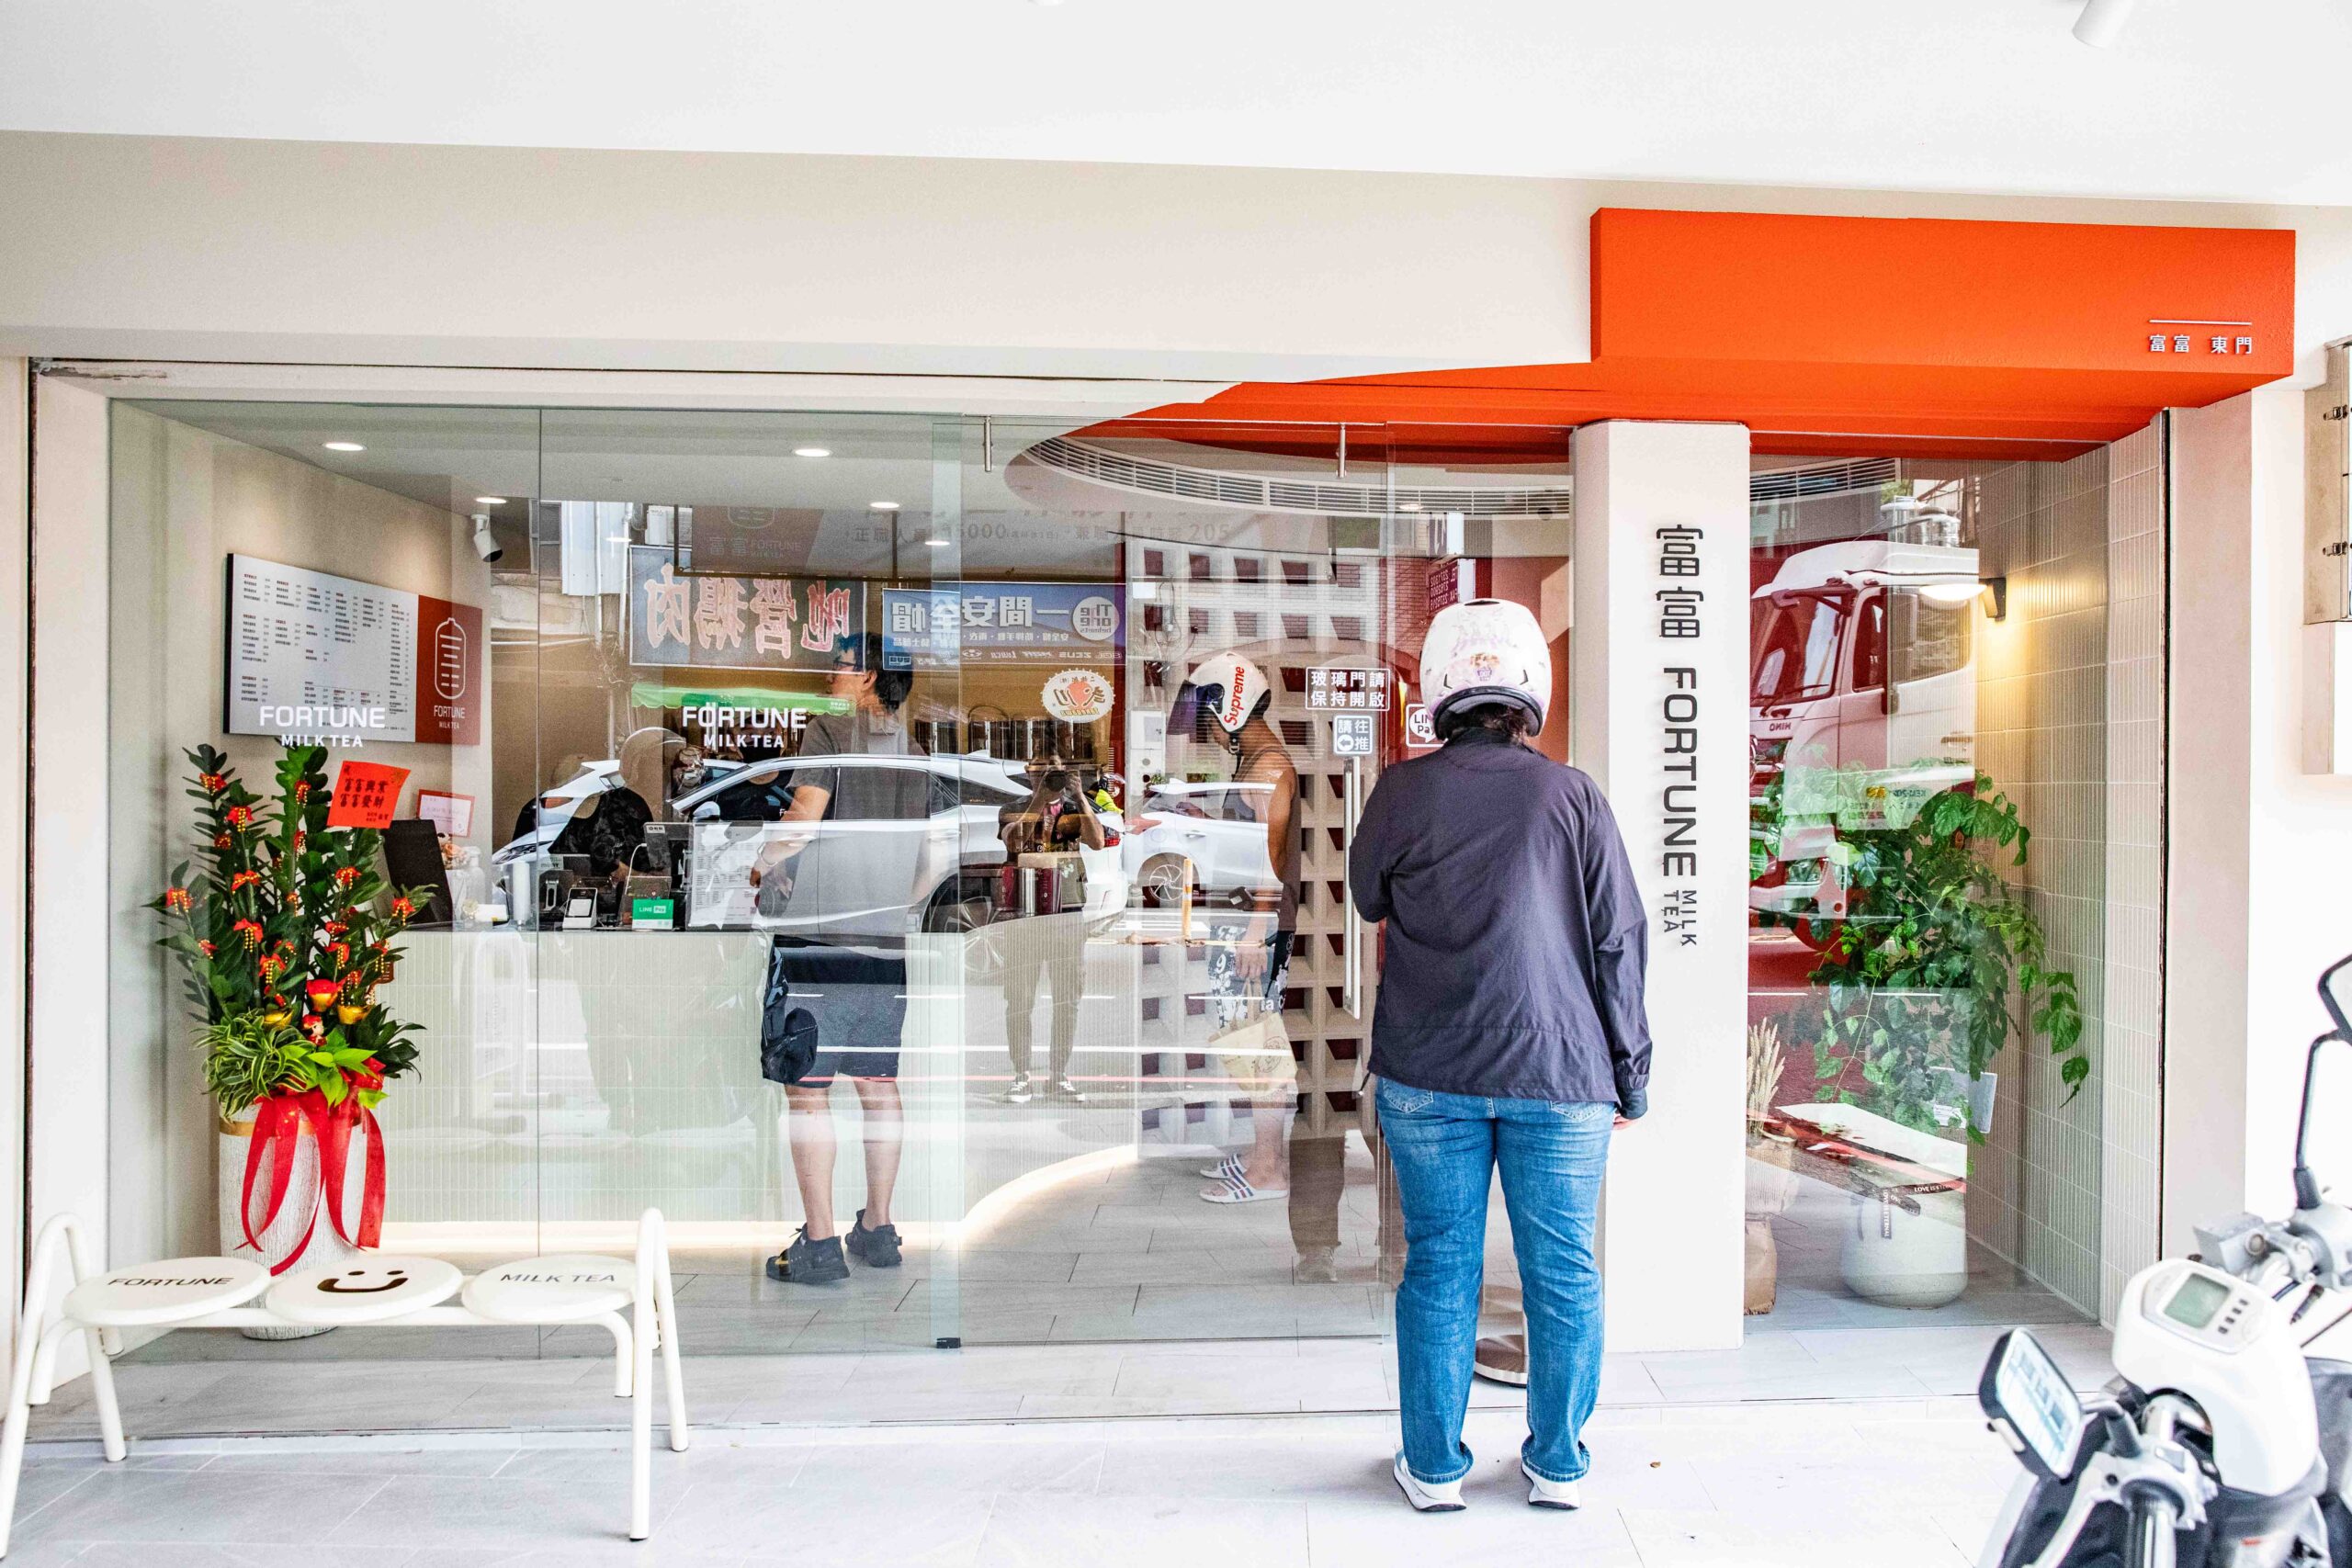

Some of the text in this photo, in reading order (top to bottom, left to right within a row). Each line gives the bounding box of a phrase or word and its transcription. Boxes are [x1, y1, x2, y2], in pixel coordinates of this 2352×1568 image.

[2149, 334, 2253, 354] 富富 東門
[1656, 524, 1704, 637] 富富
[1311, 671, 1385, 688] 玻璃門請
[1224, 666, 1245, 726] Supreme
[1311, 691, 1385, 708] 保持開啟
[260, 705, 385, 728] FORTUNE
[434, 705, 466, 719] FORTUNE
[683, 706, 807, 728] FORTUNE
[1338, 719, 1369, 734] 請往
[281, 735, 363, 748] MILK TEA
[704, 734, 785, 748] MILK TEA
[1354, 737, 1369, 750] 推
[1662, 668, 1698, 876] FORTUNE
[1664, 889, 1679, 933] TEA
[1681, 889, 1698, 946] MILK
[107, 1277, 233, 1286] FORTUNE
[500, 1274, 615, 1282] MILK TEA
